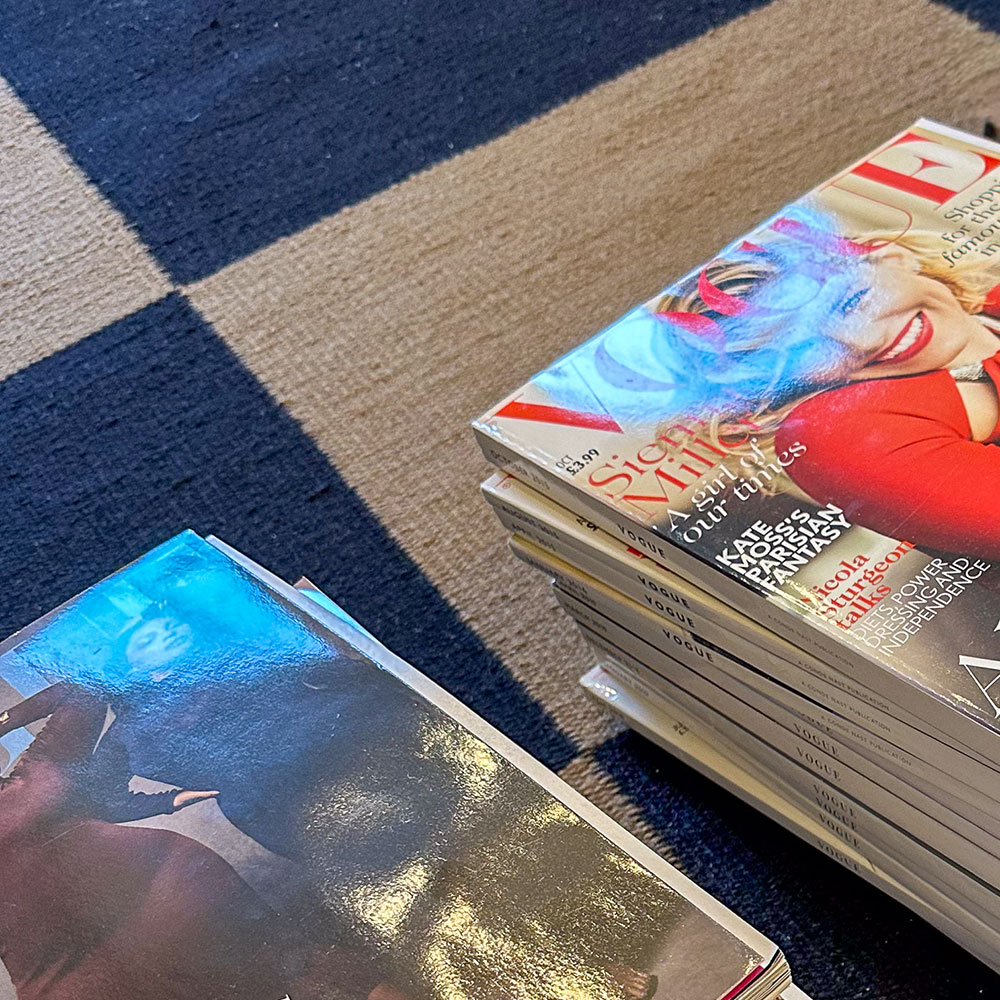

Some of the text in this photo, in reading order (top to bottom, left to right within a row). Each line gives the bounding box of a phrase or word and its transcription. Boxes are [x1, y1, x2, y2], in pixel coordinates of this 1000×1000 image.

[941, 224, 970, 244] for
[979, 236, 1000, 258] in
[556, 455, 574, 469] OCT
[567, 448, 600, 476] £3.99
[588, 405, 722, 500] Sien
[691, 464, 738, 512] girl
[740, 437, 766, 469] of
[683, 441, 808, 544] our times
[616, 524, 667, 560] VOGUE
[715, 520, 773, 566] KATE
[730, 508, 810, 575] MOSS'S
[745, 502, 843, 583] PARISIAN
[760, 514, 852, 590] FANTASY
[637, 575, 691, 609] VOGUE
[803, 554, 871, 604] icola
[819, 540, 916, 620] Sturgeon
[891, 558, 949, 605] POWER
[644, 593, 696, 629] VOGUE
[836, 584, 891, 631] talks
[864, 585, 937, 649] DRESSING
[935, 557, 969, 589] AND
[878, 559, 991, 657] INDEPENDENCE
[662, 628, 715, 663] VOGUE
[793, 722, 840, 757] VOGUE
[796, 747, 841, 782] VOGUE
